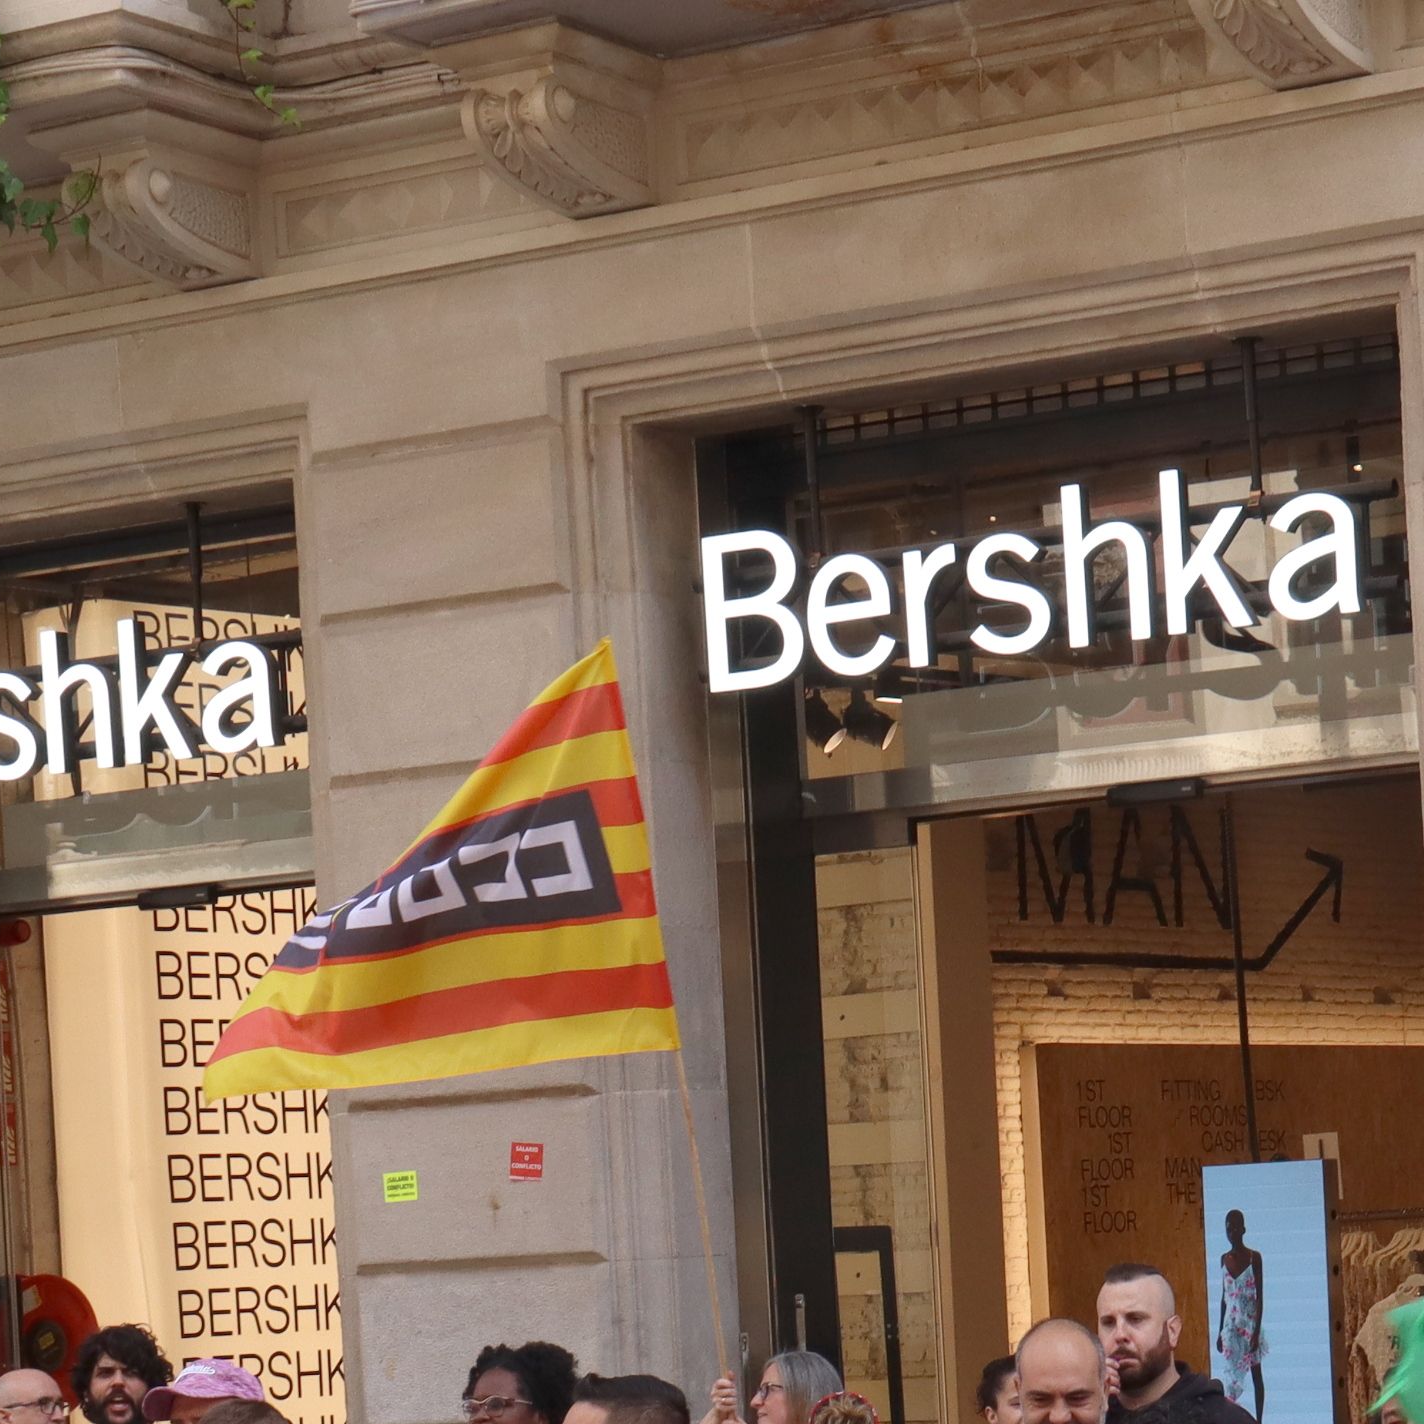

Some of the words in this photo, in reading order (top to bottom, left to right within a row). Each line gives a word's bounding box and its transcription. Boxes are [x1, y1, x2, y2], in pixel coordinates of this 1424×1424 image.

[701, 468, 1362, 693] Bershka
[1016, 806, 1233, 930] MAN
[160, 1019, 232, 1067] BE
[1078, 1106, 1133, 1128] FLOOR
[1190, 1104, 1247, 1127] ROOMS
[1202, 1130, 1244, 1153] CASH
[1259, 1129, 1287, 1151] ESK
[1081, 1157, 1135, 1181] FLOOR
[1083, 1210, 1137, 1233] FLOOR
[182, 1349, 344, 1401] RSHK
